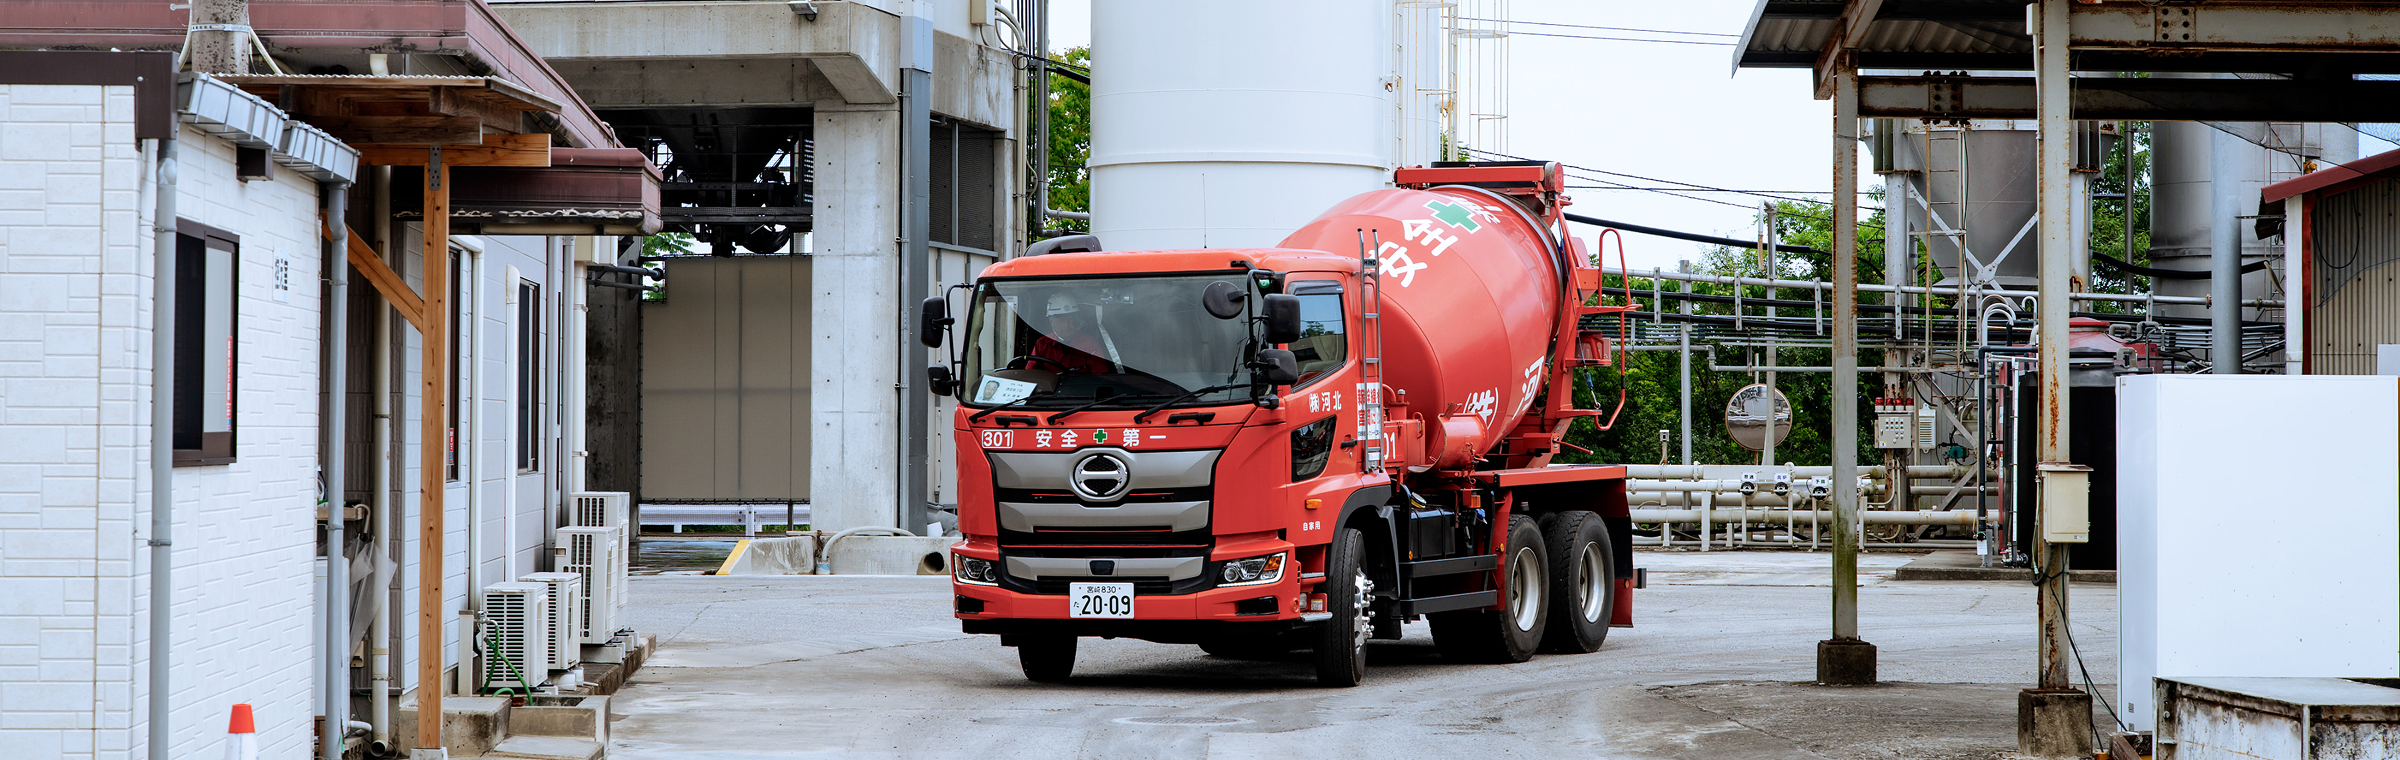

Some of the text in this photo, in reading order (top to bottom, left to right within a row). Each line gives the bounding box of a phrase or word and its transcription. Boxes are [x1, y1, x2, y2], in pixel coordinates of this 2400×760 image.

[1368, 218, 1459, 288] 安全
[983, 431, 1011, 448] 301
[1035, 428, 1167, 448] 安全 第一
[1303, 521, 1320, 531] 自家用
[1081, 595, 1131, 615] 20-09
